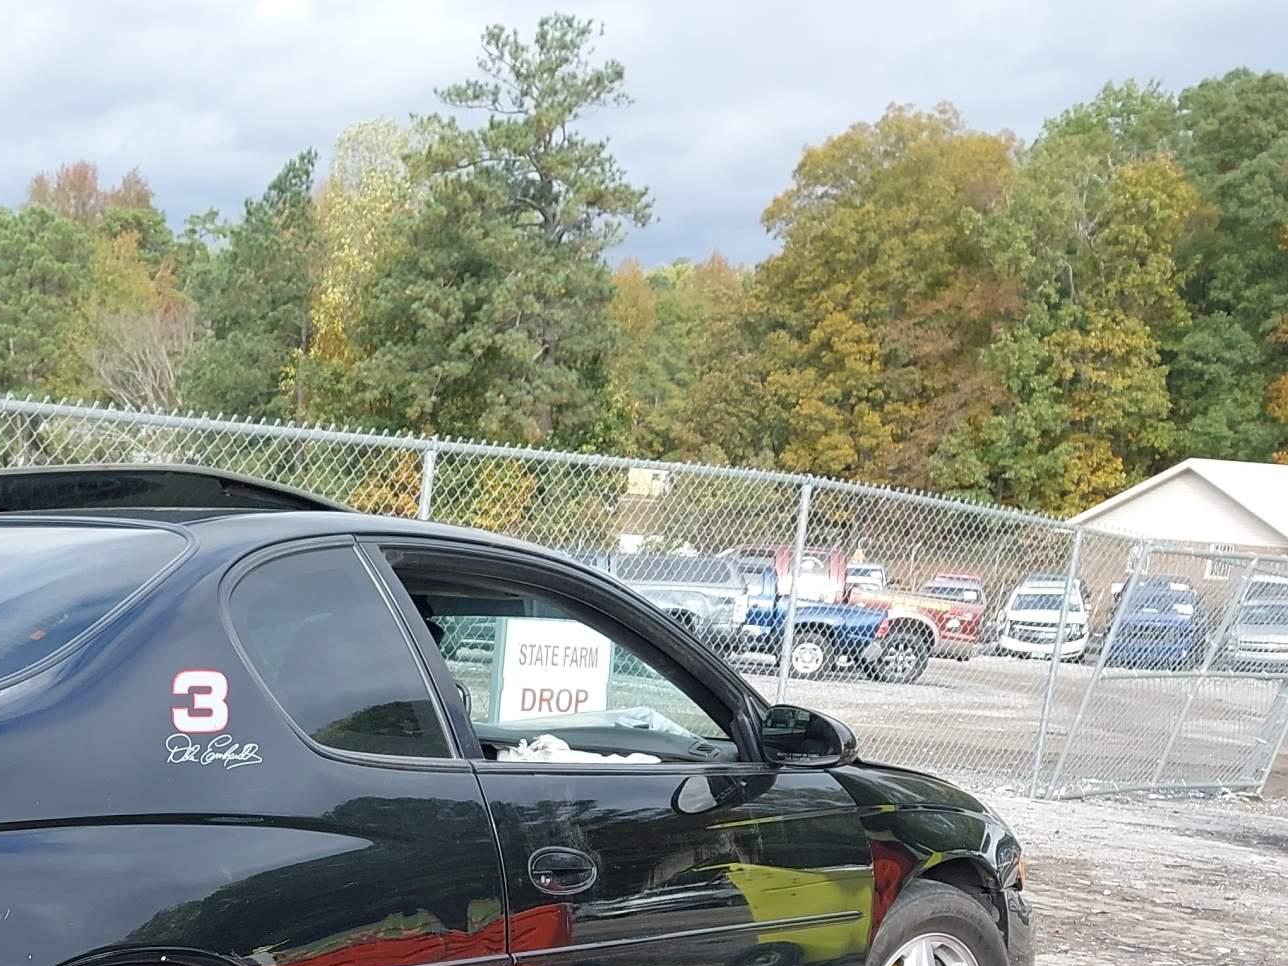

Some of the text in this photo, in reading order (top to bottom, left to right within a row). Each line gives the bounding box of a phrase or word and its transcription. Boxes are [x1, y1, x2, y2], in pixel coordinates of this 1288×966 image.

[519, 643, 599, 669] STATE FARM
[170, 668, 230, 734] 3
[520, 688, 589, 713] DROP
